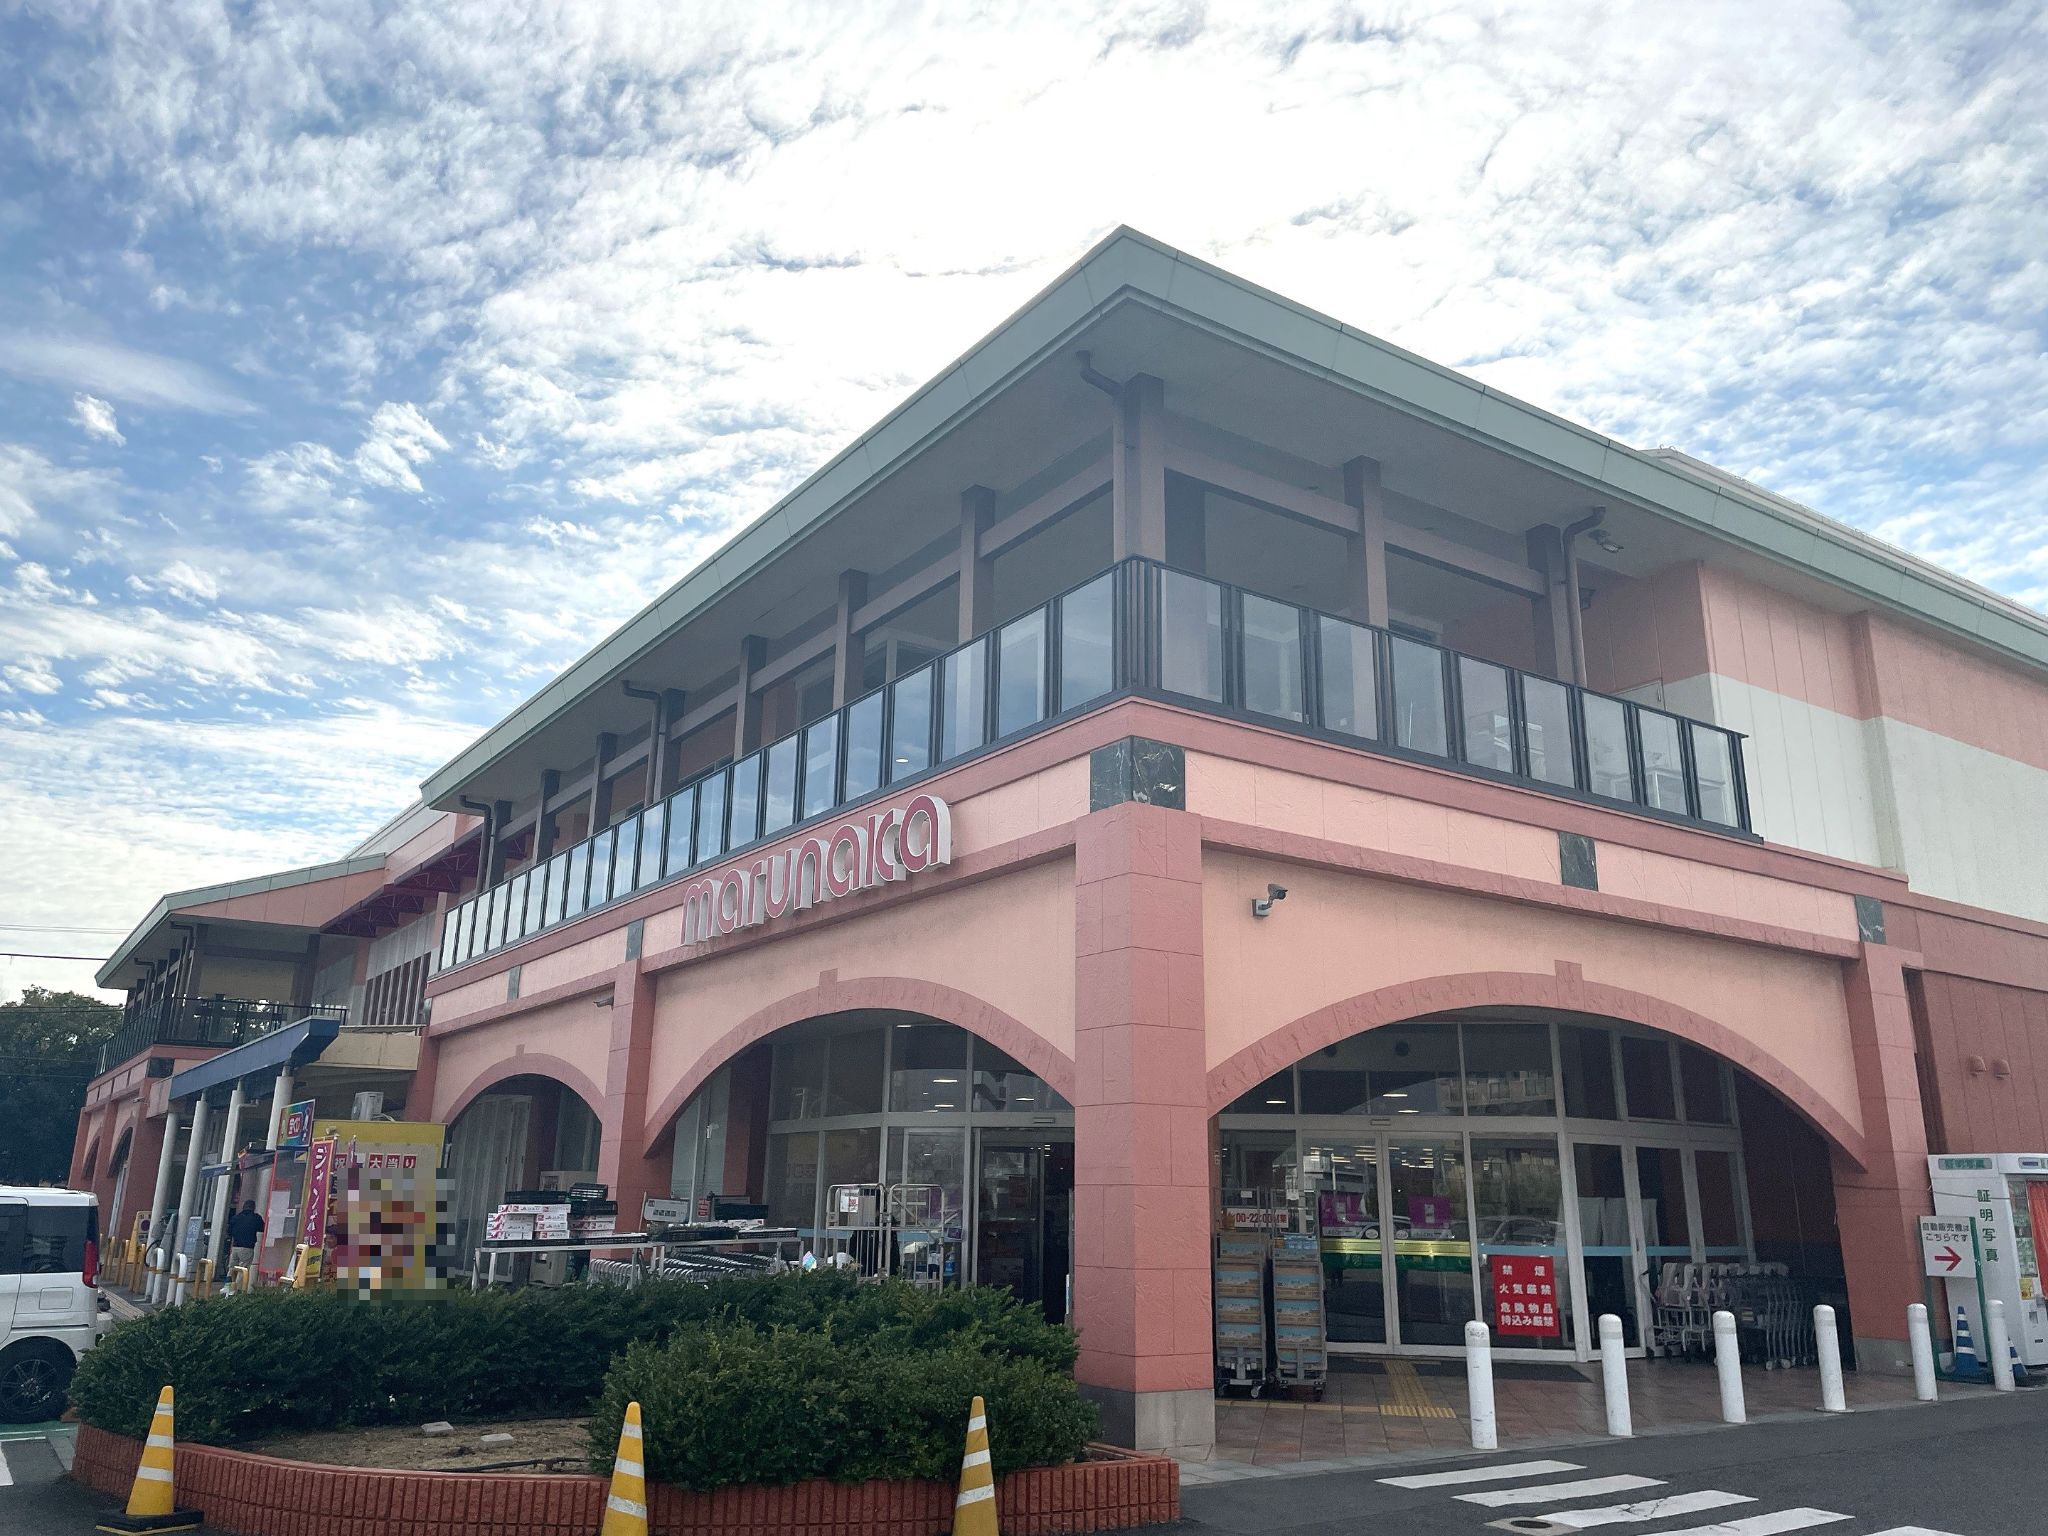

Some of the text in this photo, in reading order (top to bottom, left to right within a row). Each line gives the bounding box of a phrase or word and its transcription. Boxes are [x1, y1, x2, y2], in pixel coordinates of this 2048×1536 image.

[680, 793, 950, 946] marunaka
[1922, 1222, 1969, 1232] 自動販売機は
[1977, 1189, 1999, 1262] 証明写真
[1925, 1233, 1968, 1242] こちらです
[1499, 1283, 1552, 1295] 火気厳禁
[1500, 1302, 1553, 1314] 危険物品
[1501, 1315, 1554, 1327] 持込み厳禁
